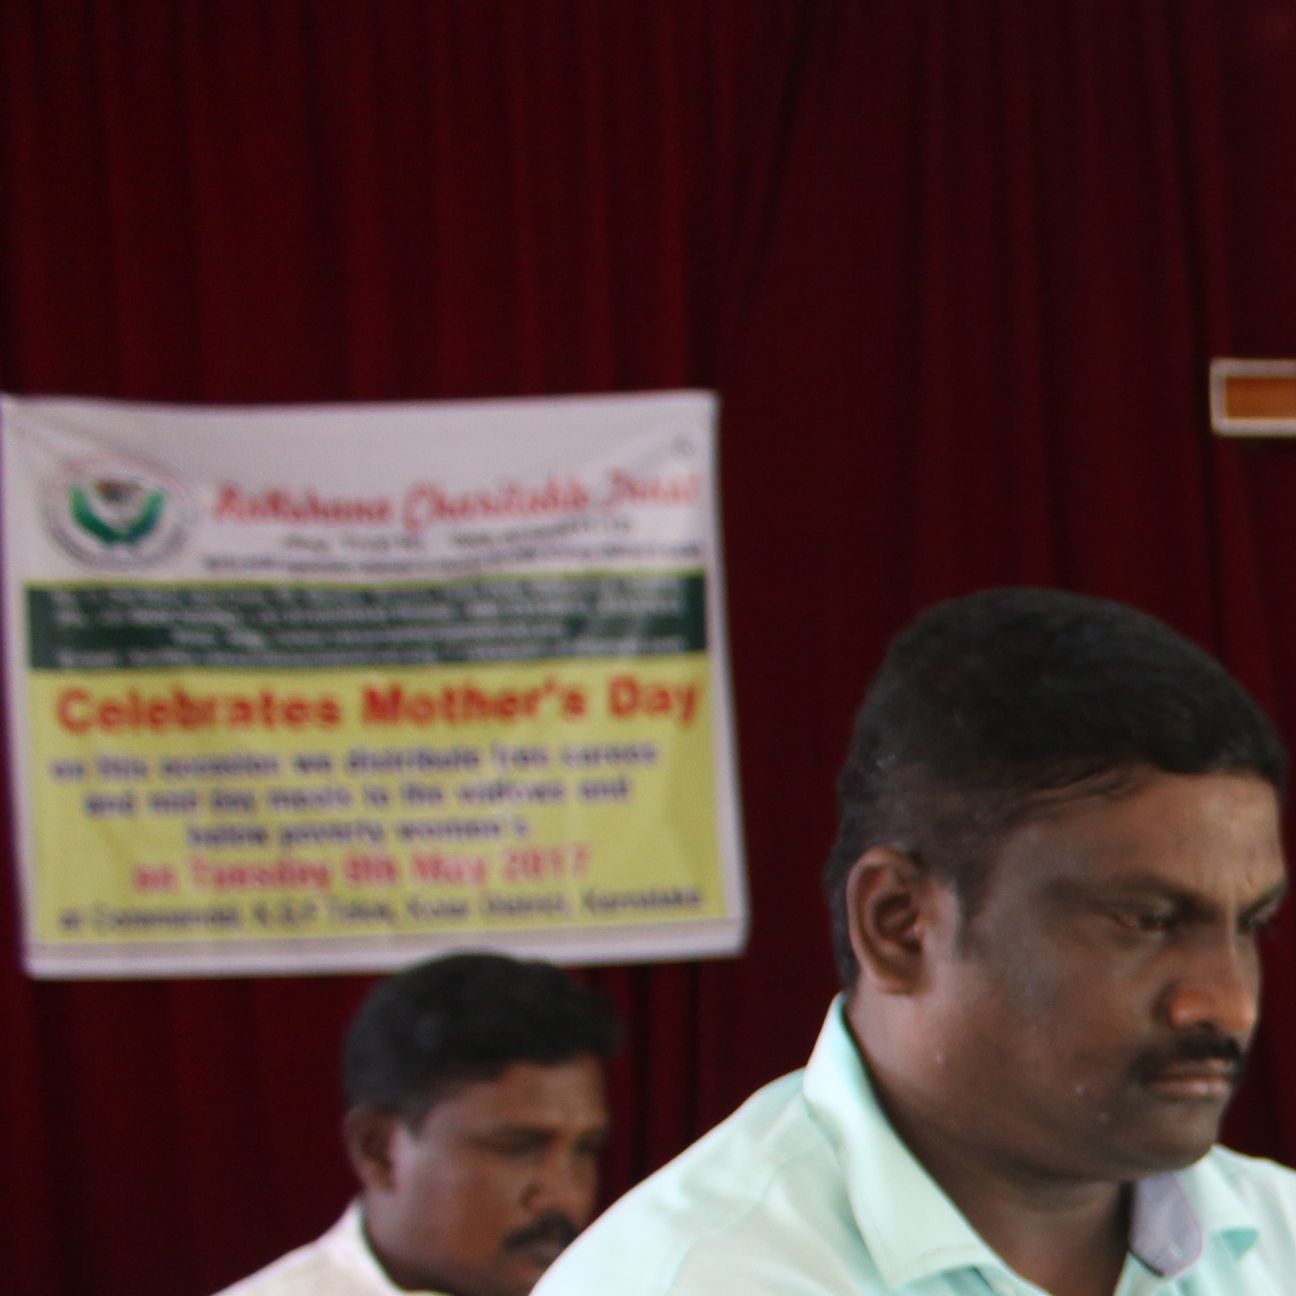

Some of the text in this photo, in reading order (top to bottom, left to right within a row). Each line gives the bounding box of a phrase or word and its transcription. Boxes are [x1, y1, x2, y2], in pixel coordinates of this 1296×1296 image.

[59, 676, 695, 732] Celebrates Mother's Day
[99, 757, 145, 777] this
[163, 755, 278, 776] occasion
[295, 755, 330, 772] we
[348, 746, 477, 772] distribute
[87, 792, 133, 816] and
[212, 790, 253, 814] day
[365, 785, 387, 804] to
[406, 784, 442, 801] the
[460, 781, 563, 800] widows
[582, 776, 626, 800] and
[283, 822, 382, 851] poverty
[136, 866, 174, 889] on
[188, 859, 329, 891] Tuesday
[412, 854, 486, 887] May
[505, 846, 587, 880] 2017
